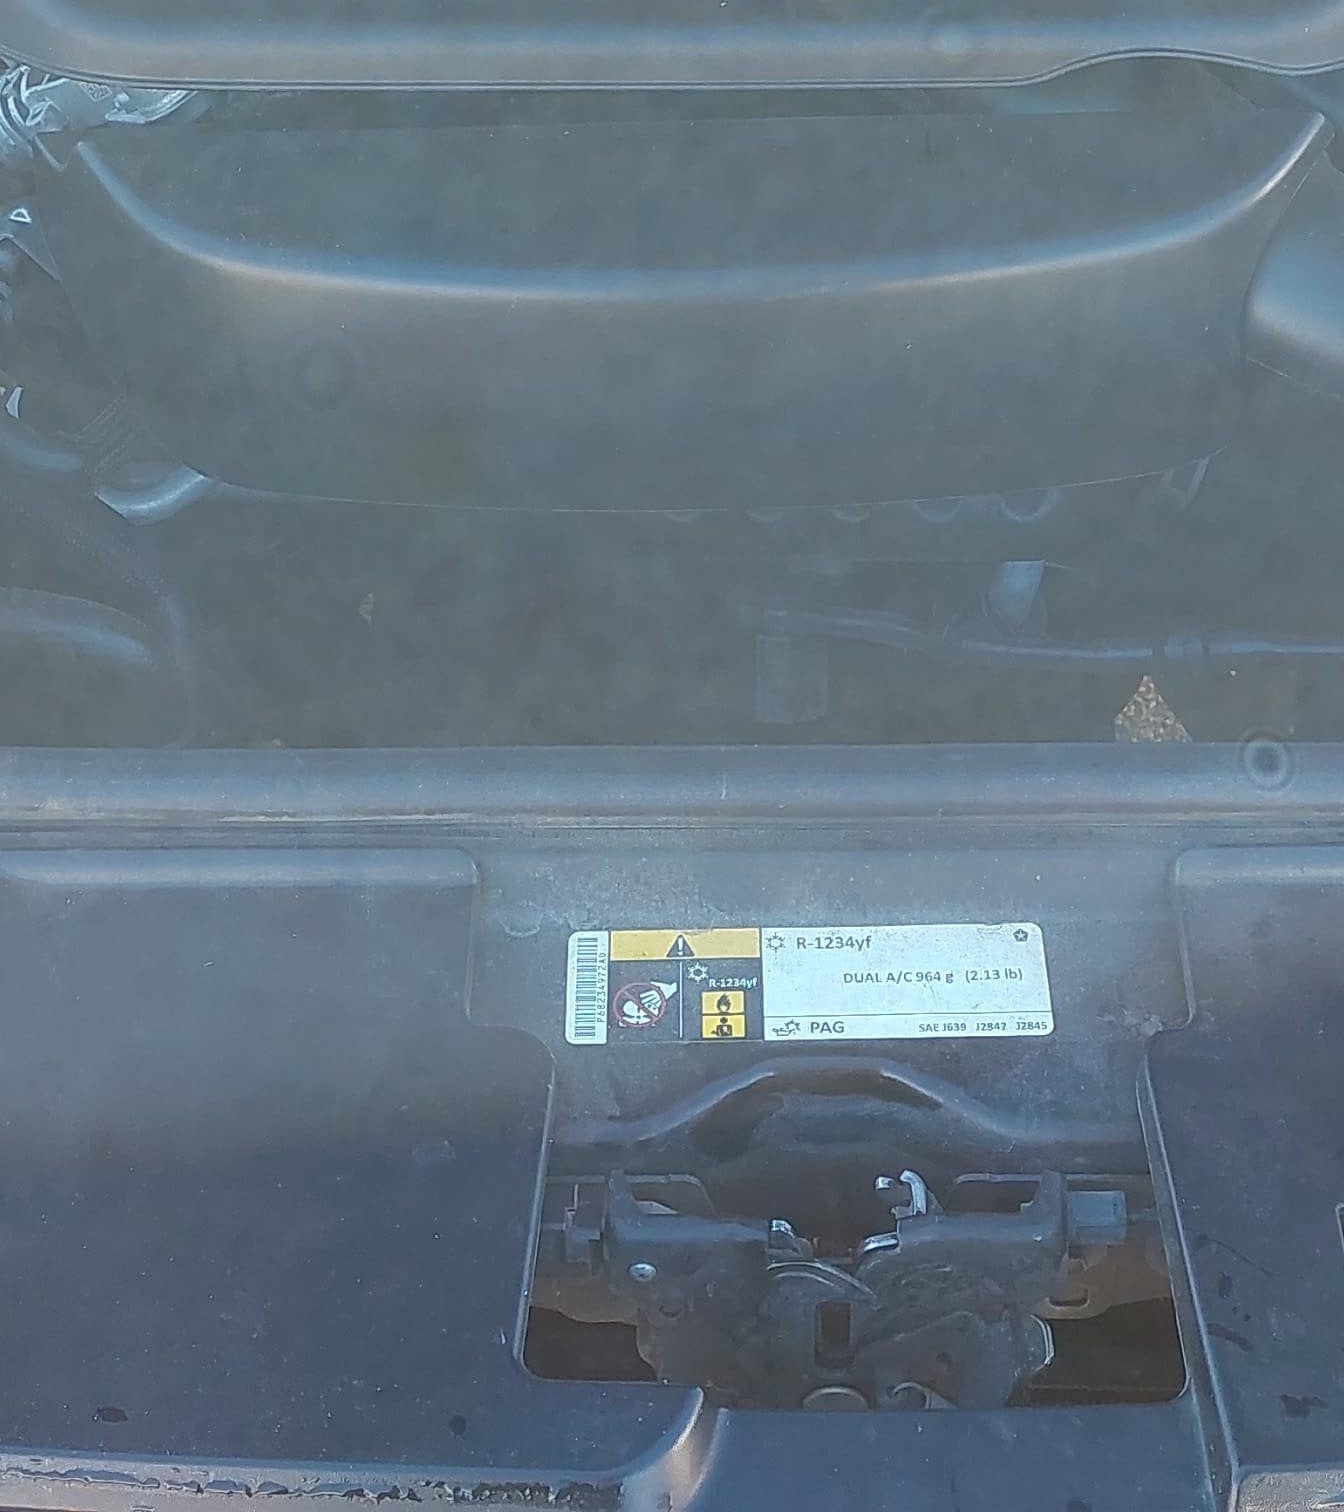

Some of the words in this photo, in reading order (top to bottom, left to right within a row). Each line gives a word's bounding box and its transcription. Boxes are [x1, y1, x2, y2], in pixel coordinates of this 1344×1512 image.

[796, 935, 872, 952] R-1234yf
[843, 971, 883, 984] DUAL
[886, 971, 913, 984] A/C
[916, 970, 942, 983] 964
[945, 972, 954, 984] g
[965, 968, 1000, 984] (2.13
[1005, 967, 1023, 981] lb)
[708, 976, 758, 990] R-1234yf
[809, 1021, 845, 1034] PAG
[918, 1023, 940, 1033] SAE
[942, 1022, 967, 1033] J639
